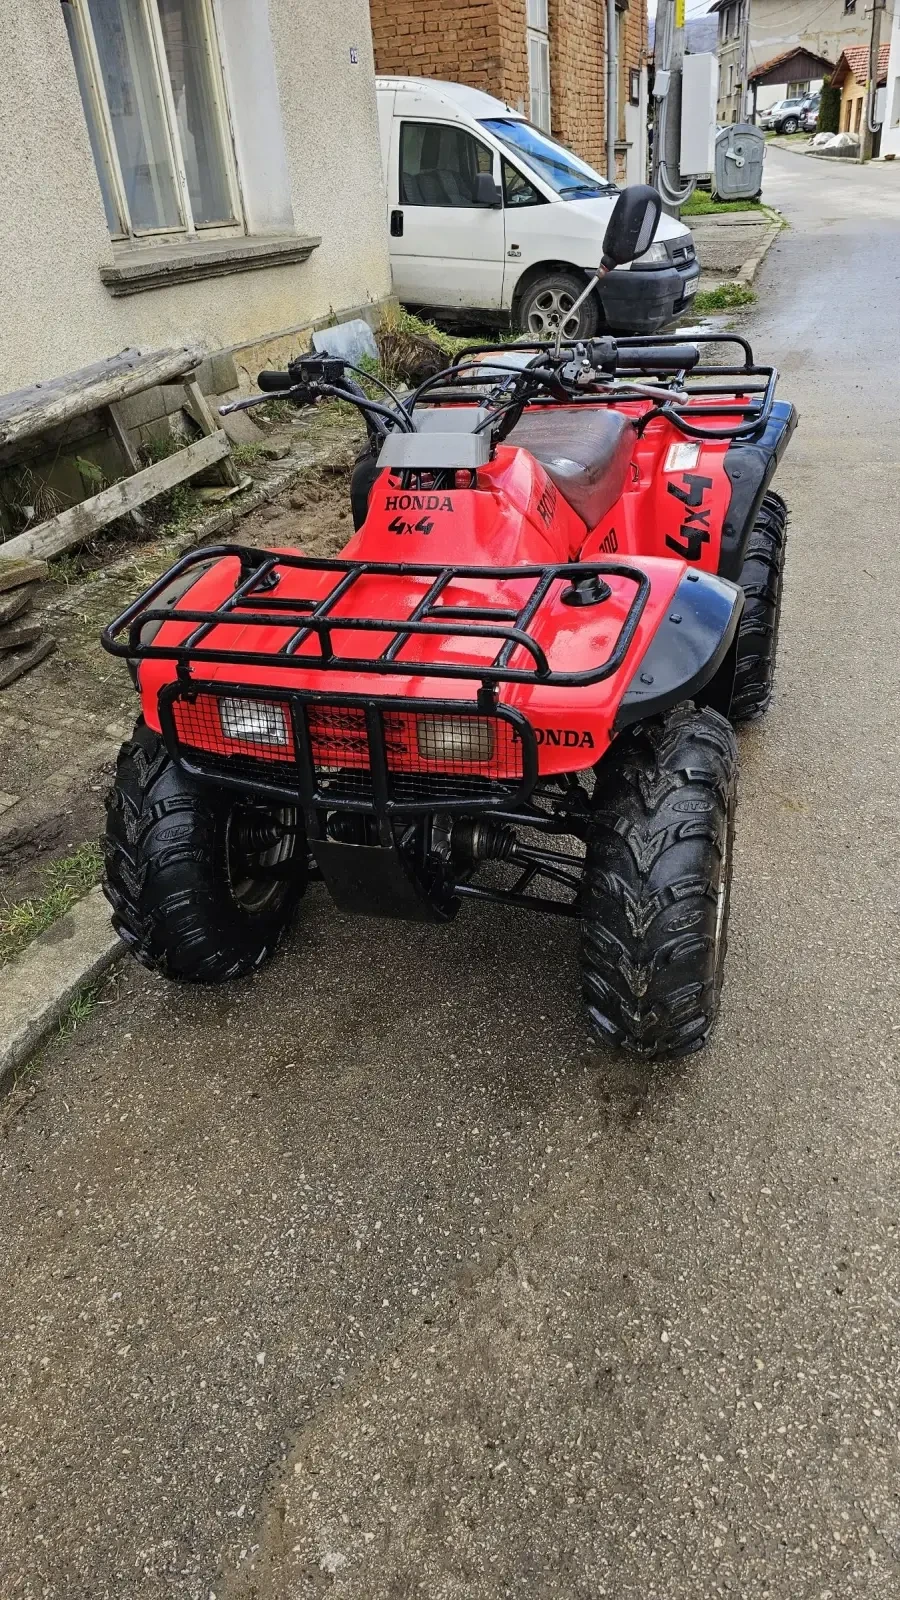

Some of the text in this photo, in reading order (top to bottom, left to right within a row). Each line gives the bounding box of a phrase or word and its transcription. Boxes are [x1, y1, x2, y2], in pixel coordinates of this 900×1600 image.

[385, 495, 454, 512] HONDA
[537, 480, 557, 530] HON
[665, 472, 713, 562] 4x4
[387, 515, 435, 535] 4x4
